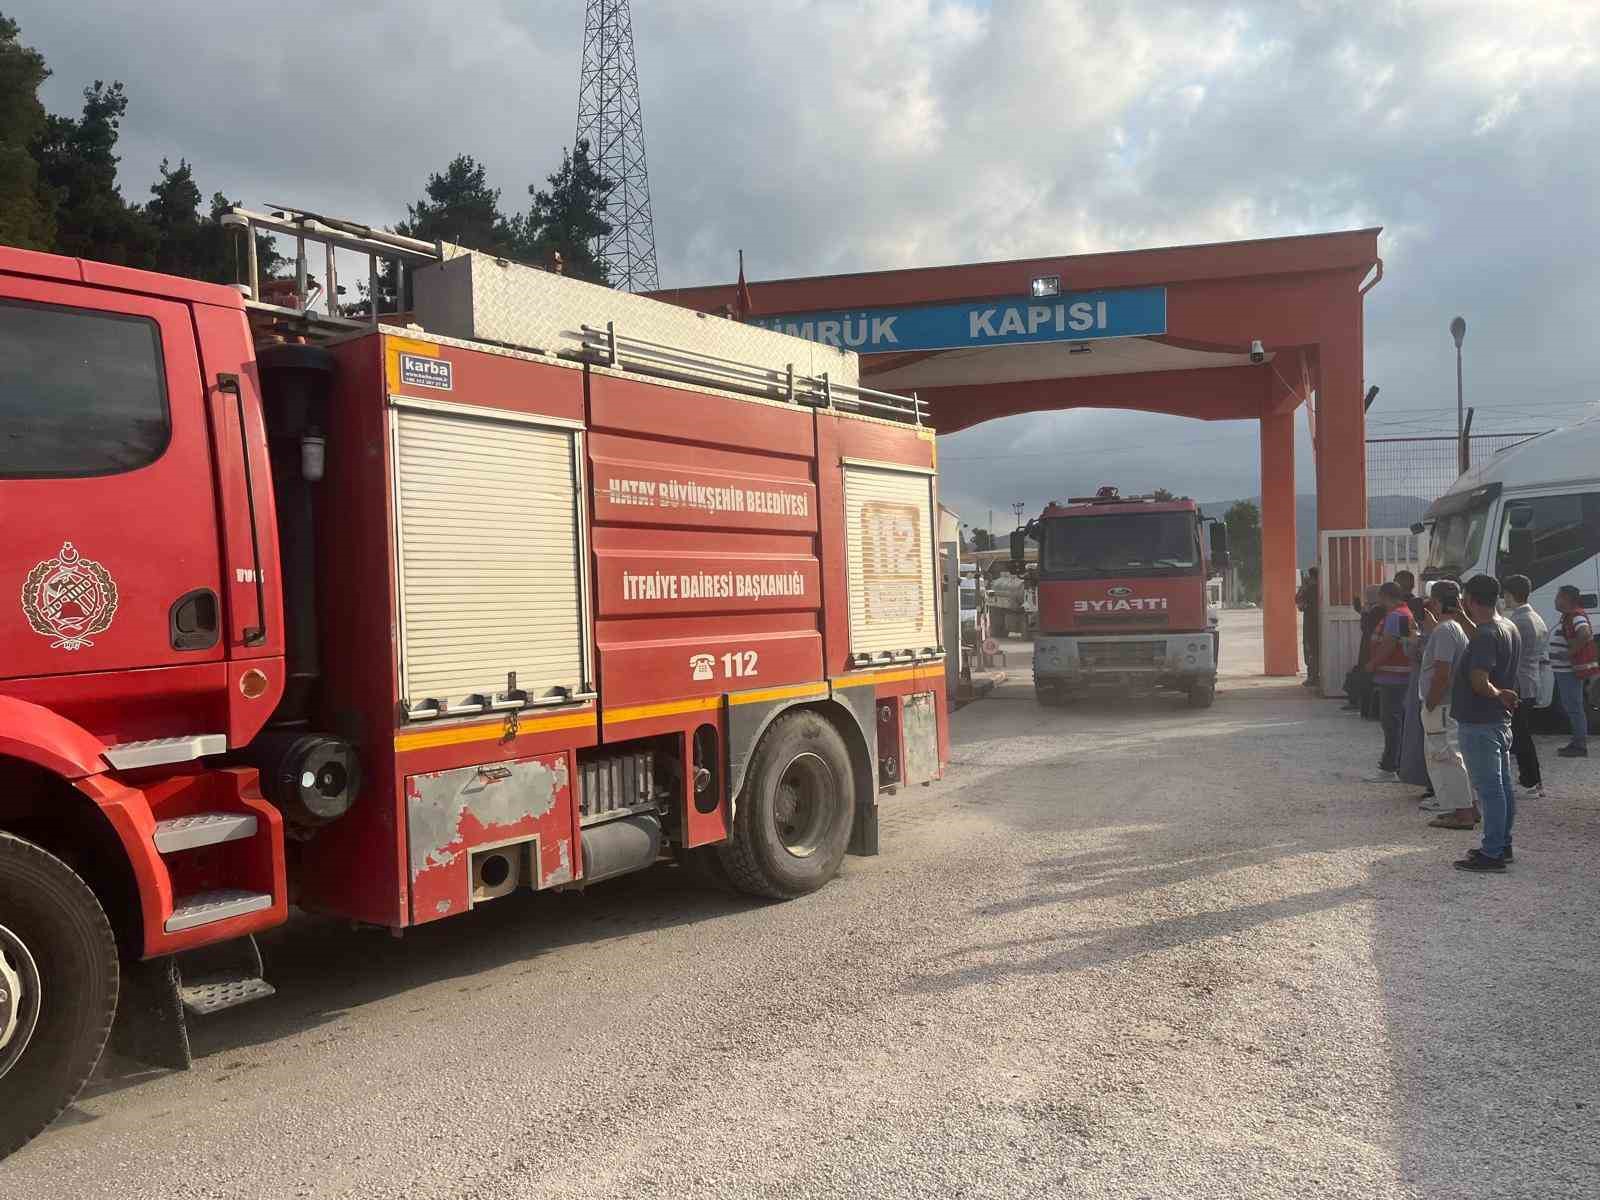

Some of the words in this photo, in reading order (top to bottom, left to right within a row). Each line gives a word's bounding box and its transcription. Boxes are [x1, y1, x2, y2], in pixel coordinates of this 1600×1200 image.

[757, 313, 898, 346] MRÜK
[969, 301, 1107, 338] KAPISI
[405, 357, 448, 376] karba
[746, 490, 808, 517] BELEDİYESİ
[623, 571, 677, 600] İTFAİYE
[681, 571, 733, 598] DAİRESİ
[736, 571, 804, 600] BAŞKANLIĞI
[721, 651, 758, 678] 112
